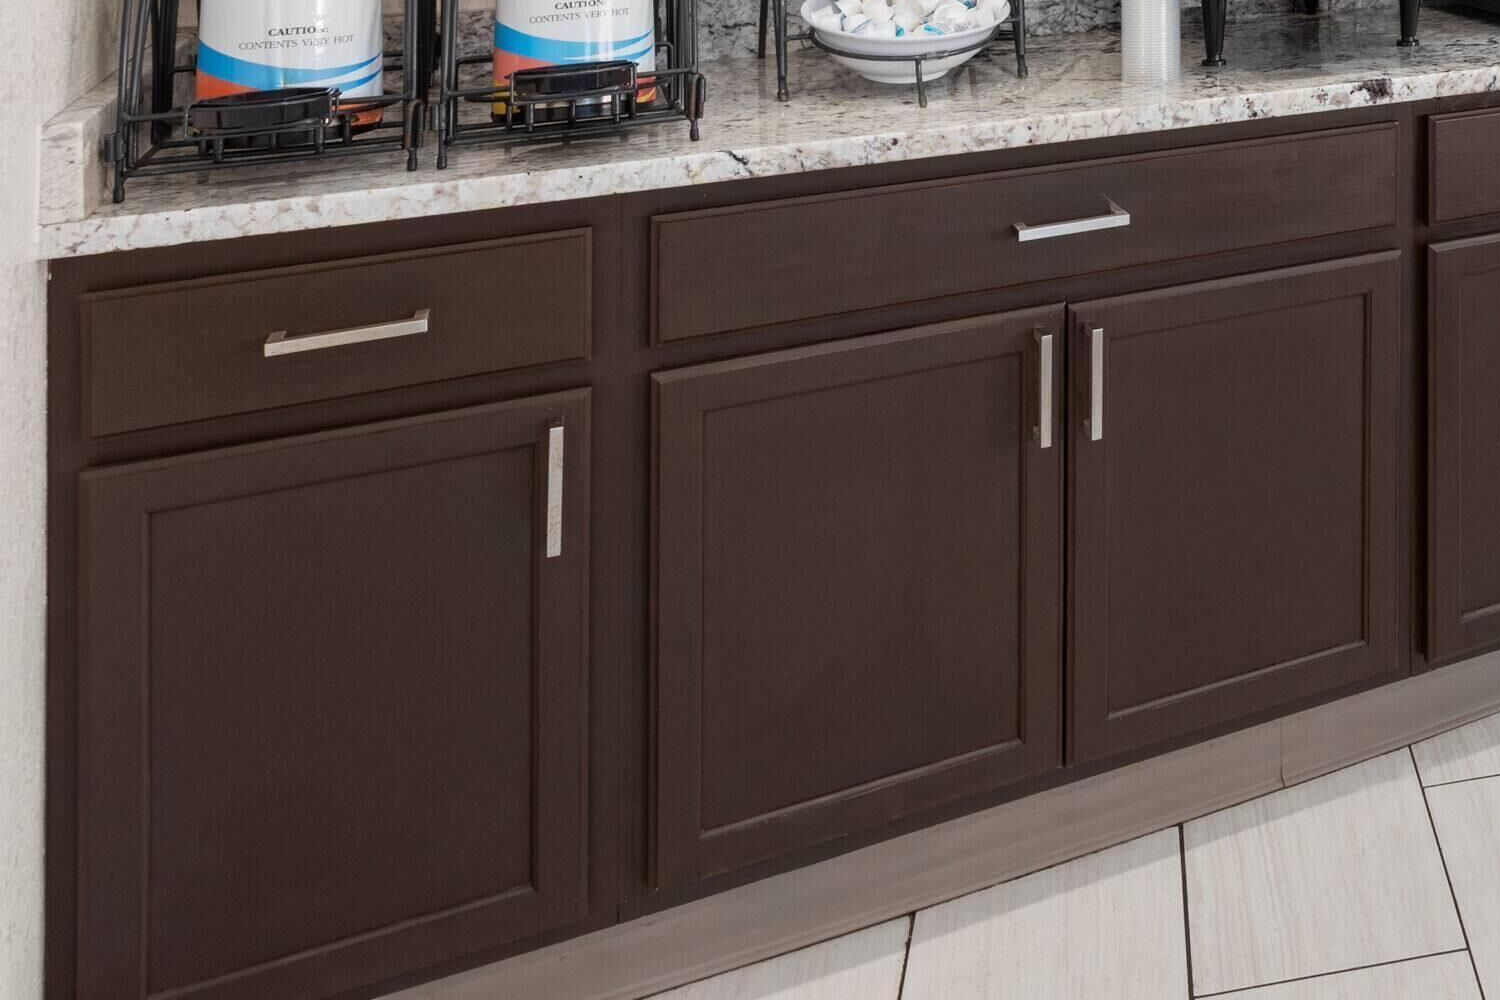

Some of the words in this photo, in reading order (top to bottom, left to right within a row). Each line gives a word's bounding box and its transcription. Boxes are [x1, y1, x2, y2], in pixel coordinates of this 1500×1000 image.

[529, 11, 581, 24] CONTENTS
[611, 7, 630, 16] HOT
[238, 39, 298, 50] CONTENTS
[333, 34, 355, 44] HOT
